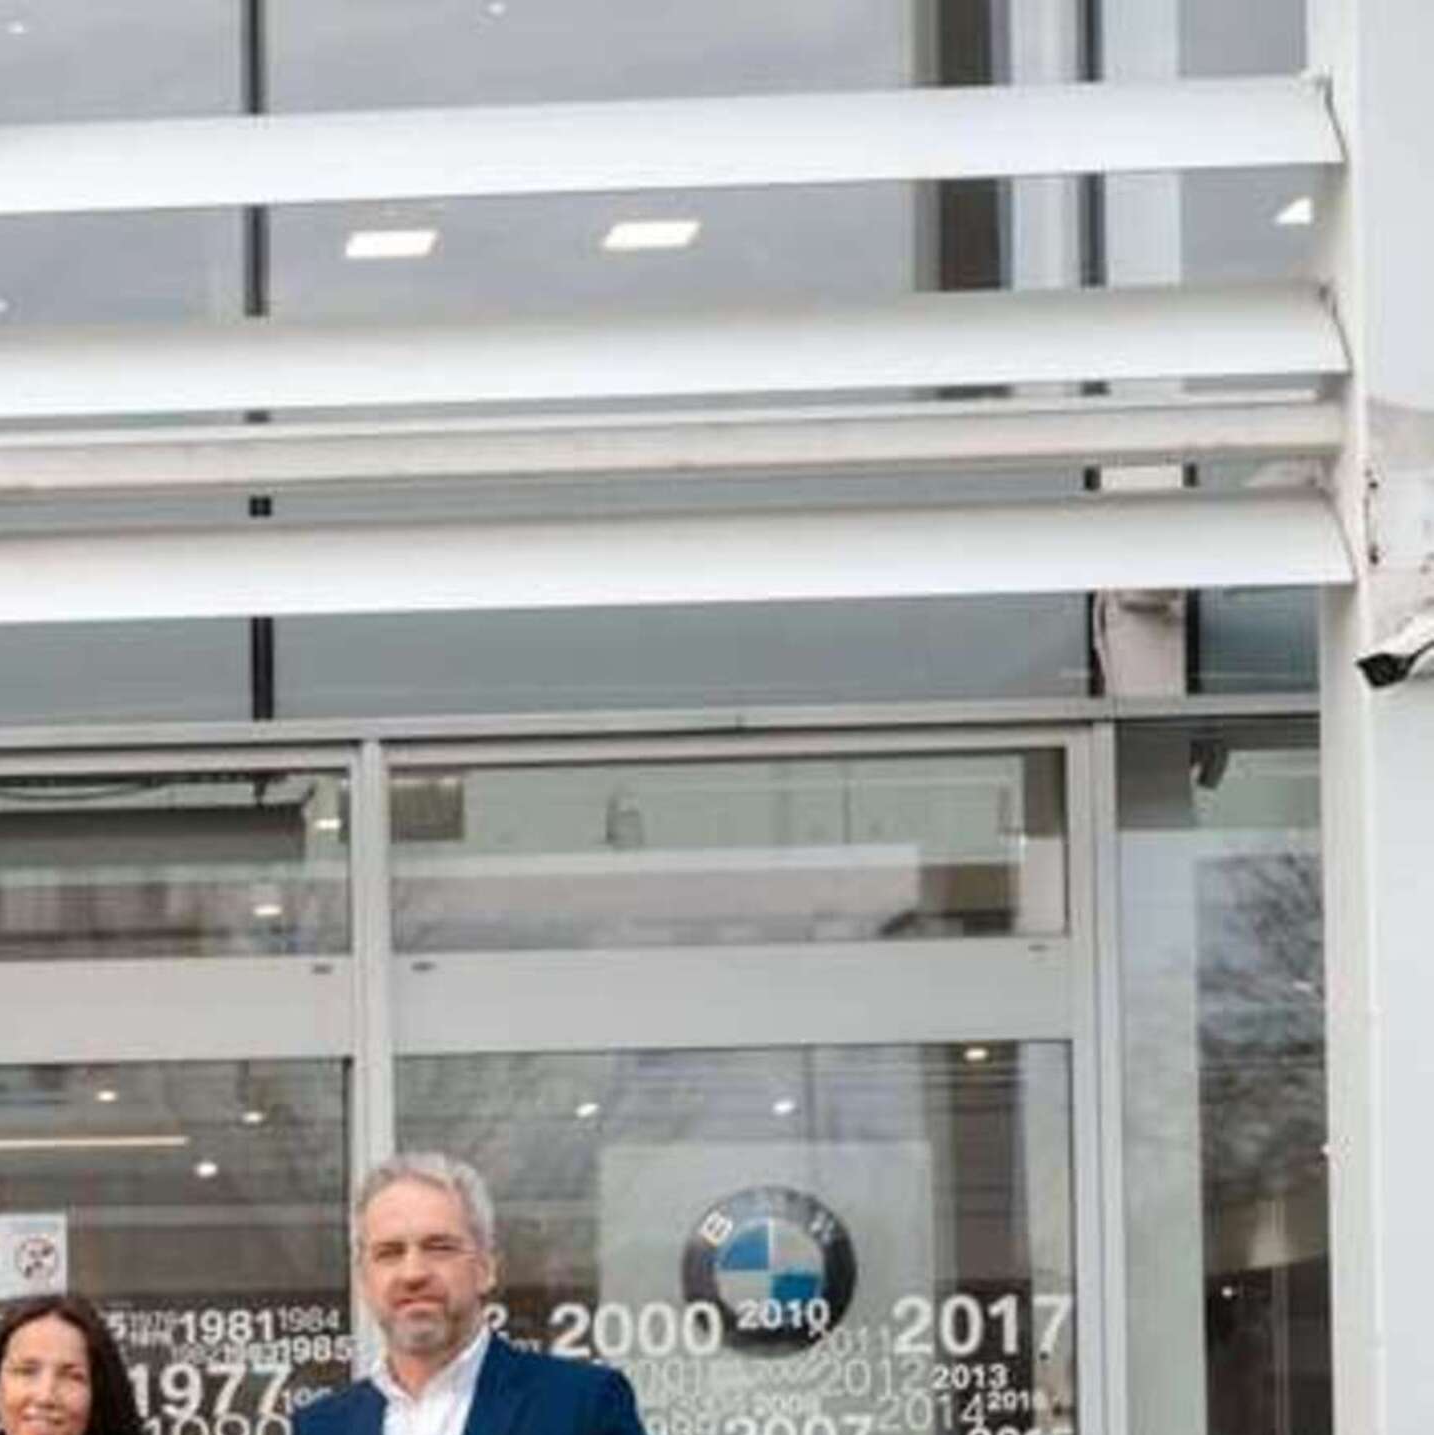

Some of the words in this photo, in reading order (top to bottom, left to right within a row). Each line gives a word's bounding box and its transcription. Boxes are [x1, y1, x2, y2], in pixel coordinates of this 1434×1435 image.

[180, 1308, 275, 1344] 1981
[277, 1304, 341, 1332] 1984
[549, 1301, 724, 1357] 2000
[736, 1297, 831, 1330] 2010
[892, 1294, 1074, 1357] 2017
[279, 1333, 353, 1364] 1985
[128, 1363, 293, 1419] 1977
[819, 1357, 928, 1399] 2012
[933, 1362, 1010, 1391] 2013
[877, 1391, 986, 1431] 2014
